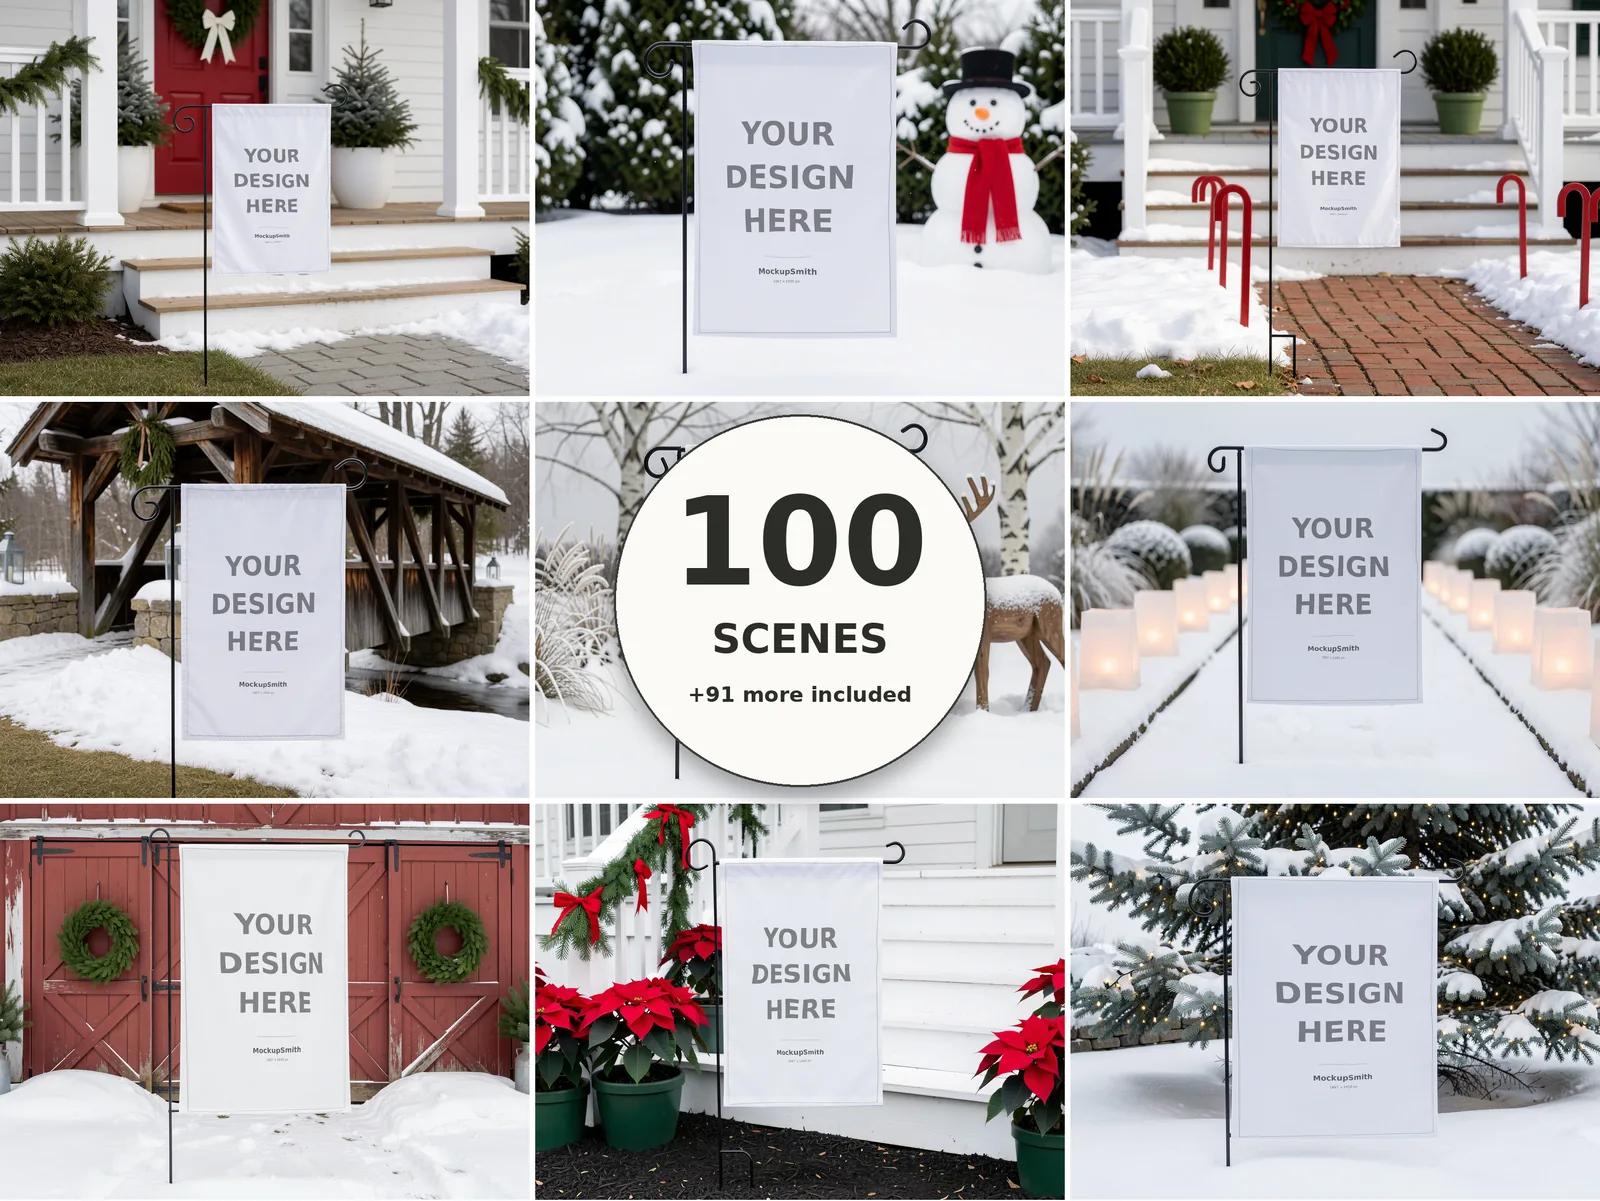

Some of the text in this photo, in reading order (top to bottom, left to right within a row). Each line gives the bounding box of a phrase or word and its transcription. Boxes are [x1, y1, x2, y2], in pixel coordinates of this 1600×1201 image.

[741, 121, 834, 146] YOUR
[1310, 118, 1367, 133] YOUR
[244, 148, 299, 163] YOUR
[1301, 144, 1377, 160] DESIGN
[234, 173, 309, 188] DESIGN
[727, 164, 853, 190] DESIGN
[1312, 170, 1365, 185] HERE
[247, 198, 297, 213] HERE
[745, 208, 832, 233] HERE
[758, 267, 818, 277] MockupSmith
[1292, 517, 1374, 539] YOUR
[225, 555, 301, 576] YOUR
[1279, 555, 1389, 577] DESIGN
[213, 592, 315, 614] DESIGN
[1296, 593, 1371, 615] HERE
[229, 631, 298, 651] HERE
[1307, 644, 1360, 654] MockupSmith
[238, 680, 288, 689] MockupSmith
[234, 913, 312, 935] YOUR
[764, 927, 837, 949] YOUR
[220, 952, 323, 974] DESIGN
[1292, 944, 1388, 966] YOUR
[752, 964, 851, 984] DESIGN
[240, 991, 311, 1013] HERE
[1276, 982, 1403, 1004] DESIGN
[767, 999, 835, 1020] HERE
[1299, 1020, 1385, 1042] HERE
[252, 1045, 302, 1056] MockupSmith
[776, 1048, 825, 1057] MockupSmith
[1312, 1073, 1373, 1083] MockupSmith
